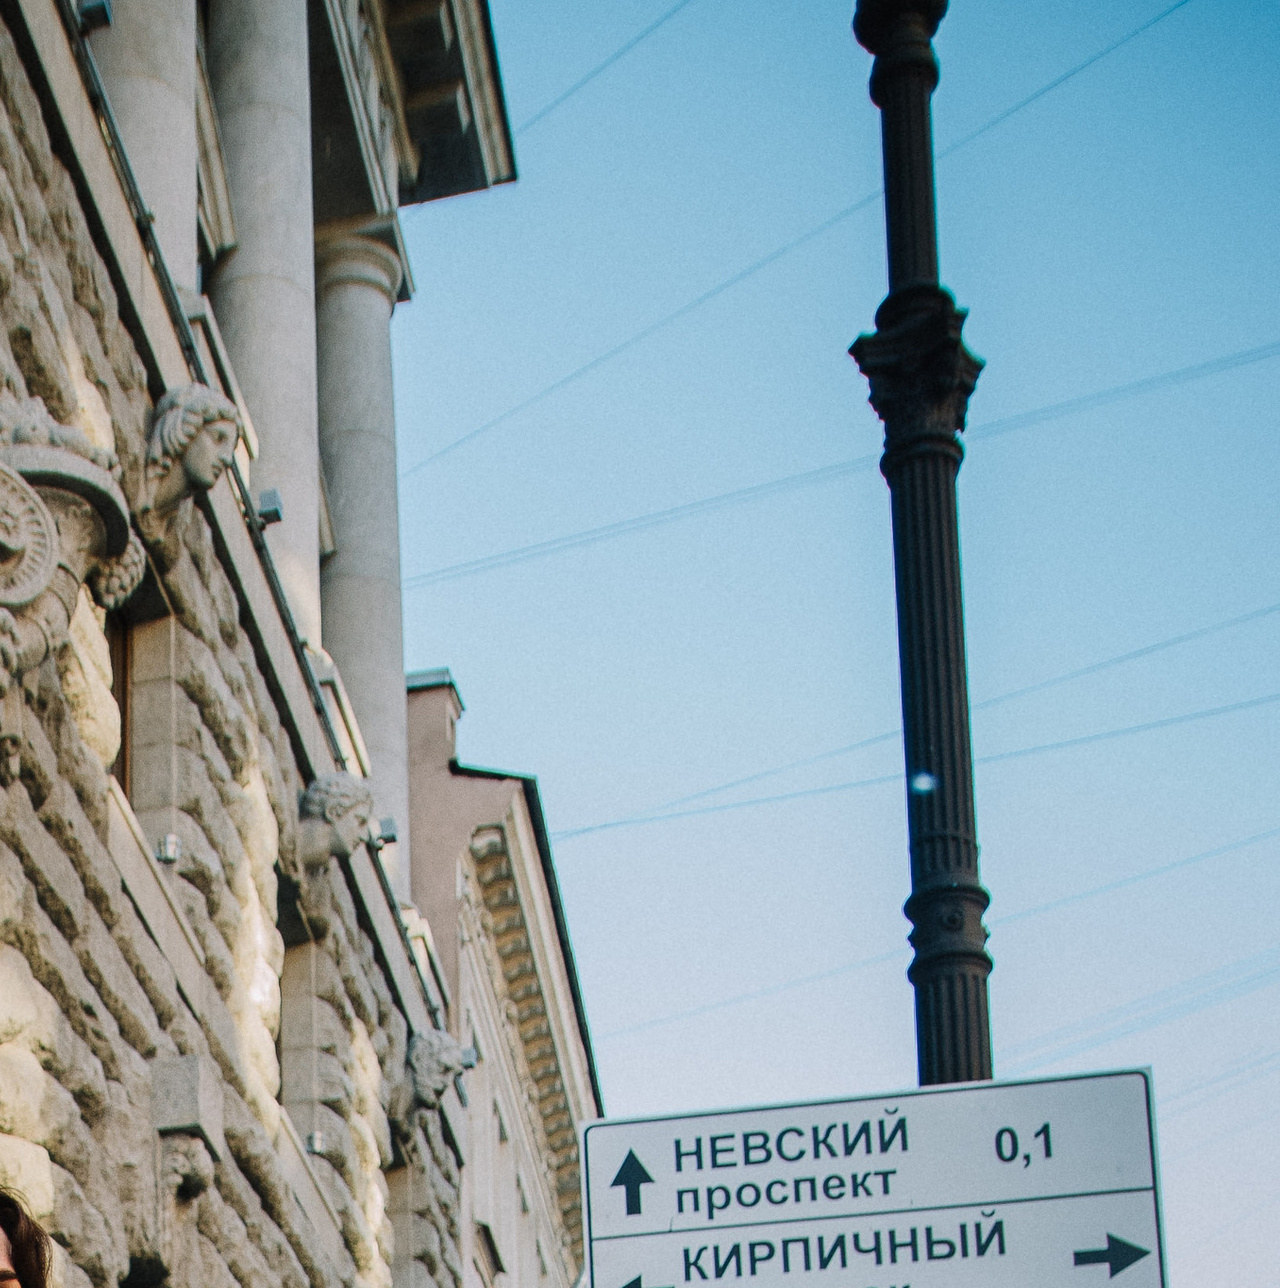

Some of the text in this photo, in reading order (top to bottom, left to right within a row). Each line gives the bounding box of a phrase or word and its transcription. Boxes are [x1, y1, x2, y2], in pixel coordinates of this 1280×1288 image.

[673, 1107, 1053, 1173] НЕВСКИЙ 0,1
[675, 1169, 898, 1220] проспект
[682, 1210, 1006, 1282] КИРПИЧНЫЙ
